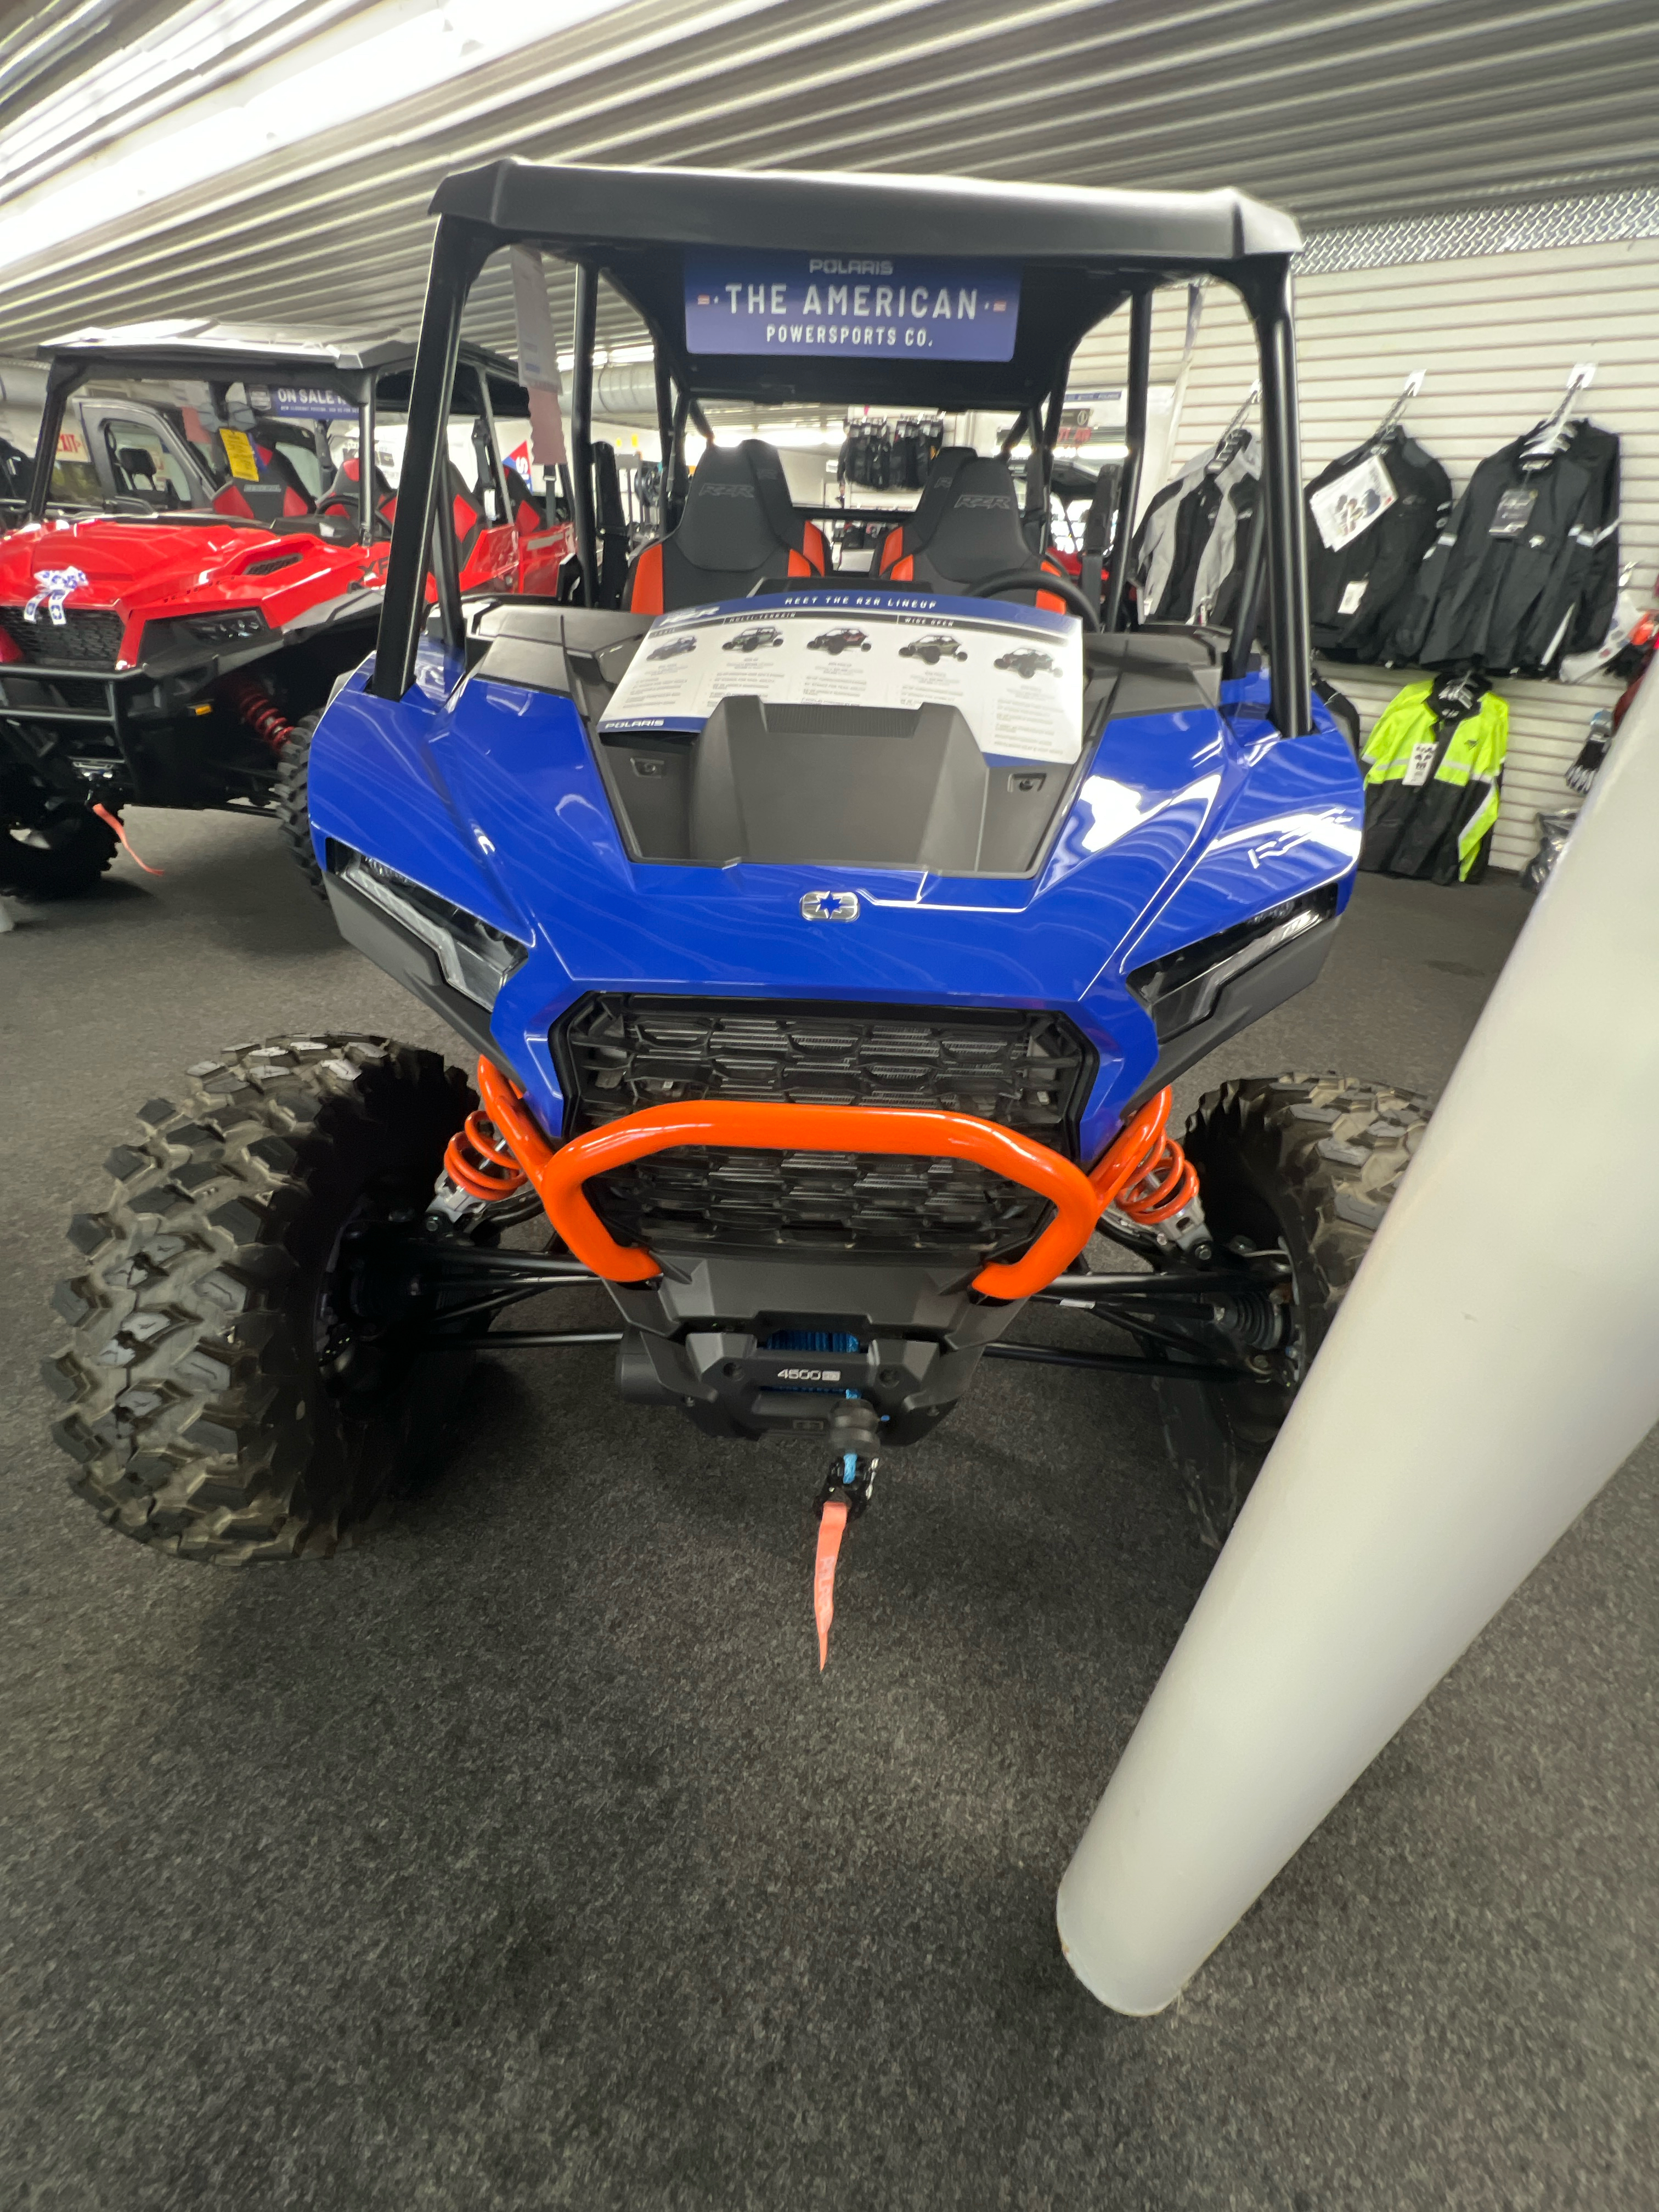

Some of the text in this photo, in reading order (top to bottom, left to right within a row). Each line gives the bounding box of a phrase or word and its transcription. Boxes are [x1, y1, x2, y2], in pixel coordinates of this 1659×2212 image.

[809, 258, 893, 275] POLARIS
[725, 283, 978, 320] THE AMERICAN
[766, 324, 933, 347] POWERSPORTS CO.
[278, 387, 297, 403] ON
[298, 388, 335, 404] SALE
[698, 483, 755, 498] RZR
[953, 494, 1011, 510] RZR
[785, 596, 936, 609] MEET THE RZR LINEUP
[729, 612, 797, 623] MULTI-TERRAIN
[930, 618, 954, 627] OPEN
[604, 719, 665, 730] POLARIS
[777, 1368, 822, 1380] 4500
